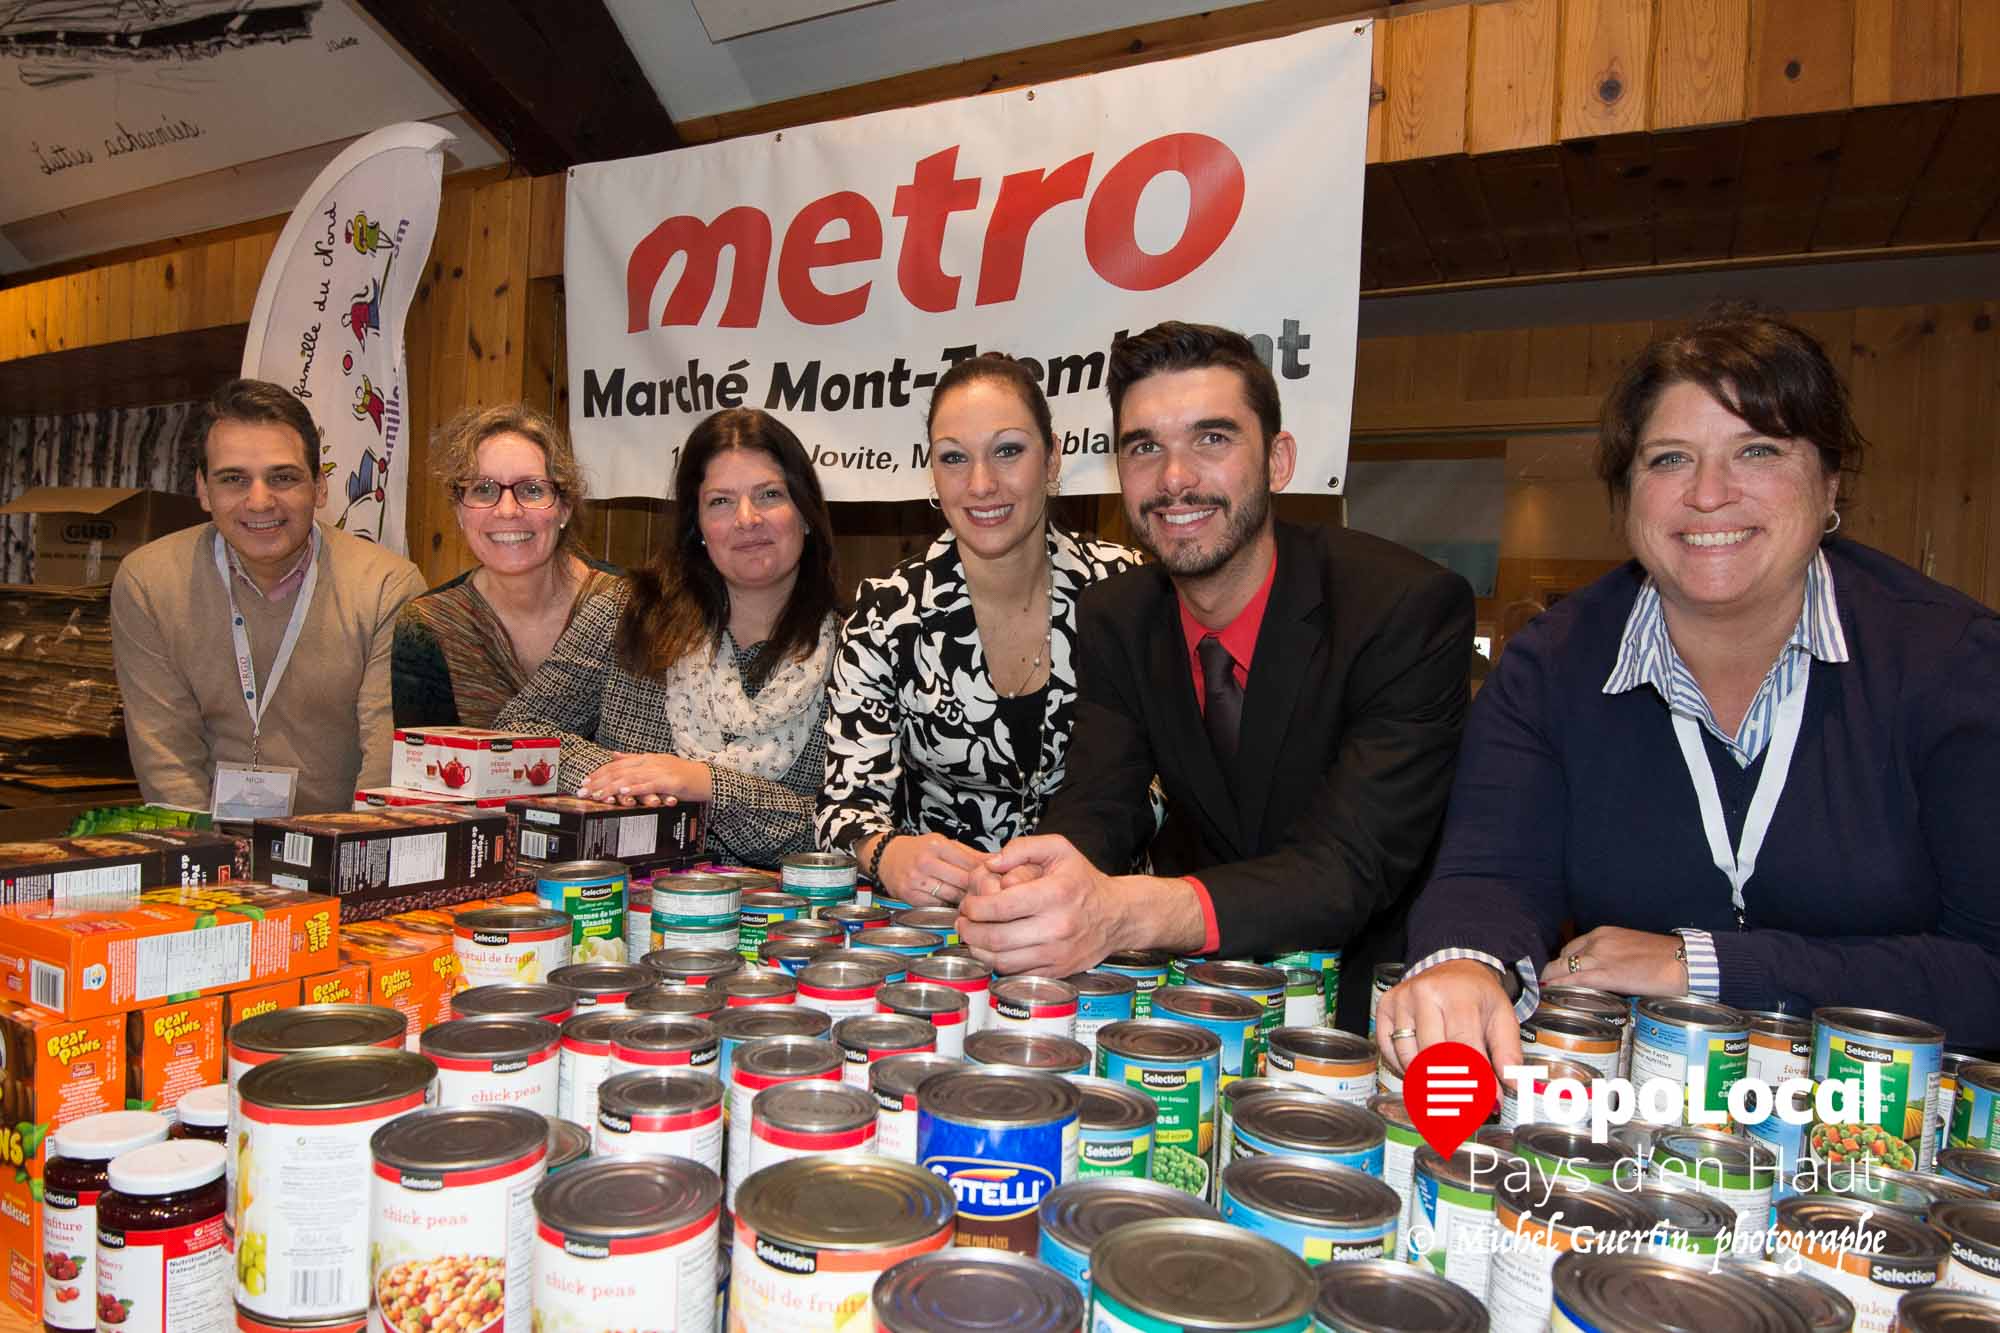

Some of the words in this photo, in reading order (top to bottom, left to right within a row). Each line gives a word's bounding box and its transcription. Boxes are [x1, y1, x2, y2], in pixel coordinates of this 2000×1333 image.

[314, 201, 337, 267] Nord
[627, 132, 1246, 334] metro
[313, 279, 331, 312] du
[293, 321, 322, 400] famille
[583, 357, 751, 418] Marché
[808, 443, 900, 474] Jovite,
[582, 887, 612, 897] Selection
[313, 911, 332, 949] Pattes
[474, 933, 508, 944] Selection
[313, 979, 341, 1002] Bear
[381, 969, 411, 991] Pattes
[997, 1004, 1030, 1019] Selection
[154, 1010, 189, 1037] Bear
[164, 1019, 202, 1045] Paws
[48, 1029, 88, 1057] Bear
[59, 1039, 102, 1066] Paws
[1846, 1043, 1892, 1063] Selection
[493, 1060, 528, 1073] Selection
[1143, 1072, 1186, 1085] Selection
[472, 1086, 511, 1103] chick
[514, 1084, 542, 1101] peas
[1086, 1144, 1132, 1158] Selection
[427, 1213, 469, 1230] peas
[757, 1239, 816, 1272] Selection
[1871, 1265, 1937, 1284] Selection
[591, 1284, 637, 1301] peas
